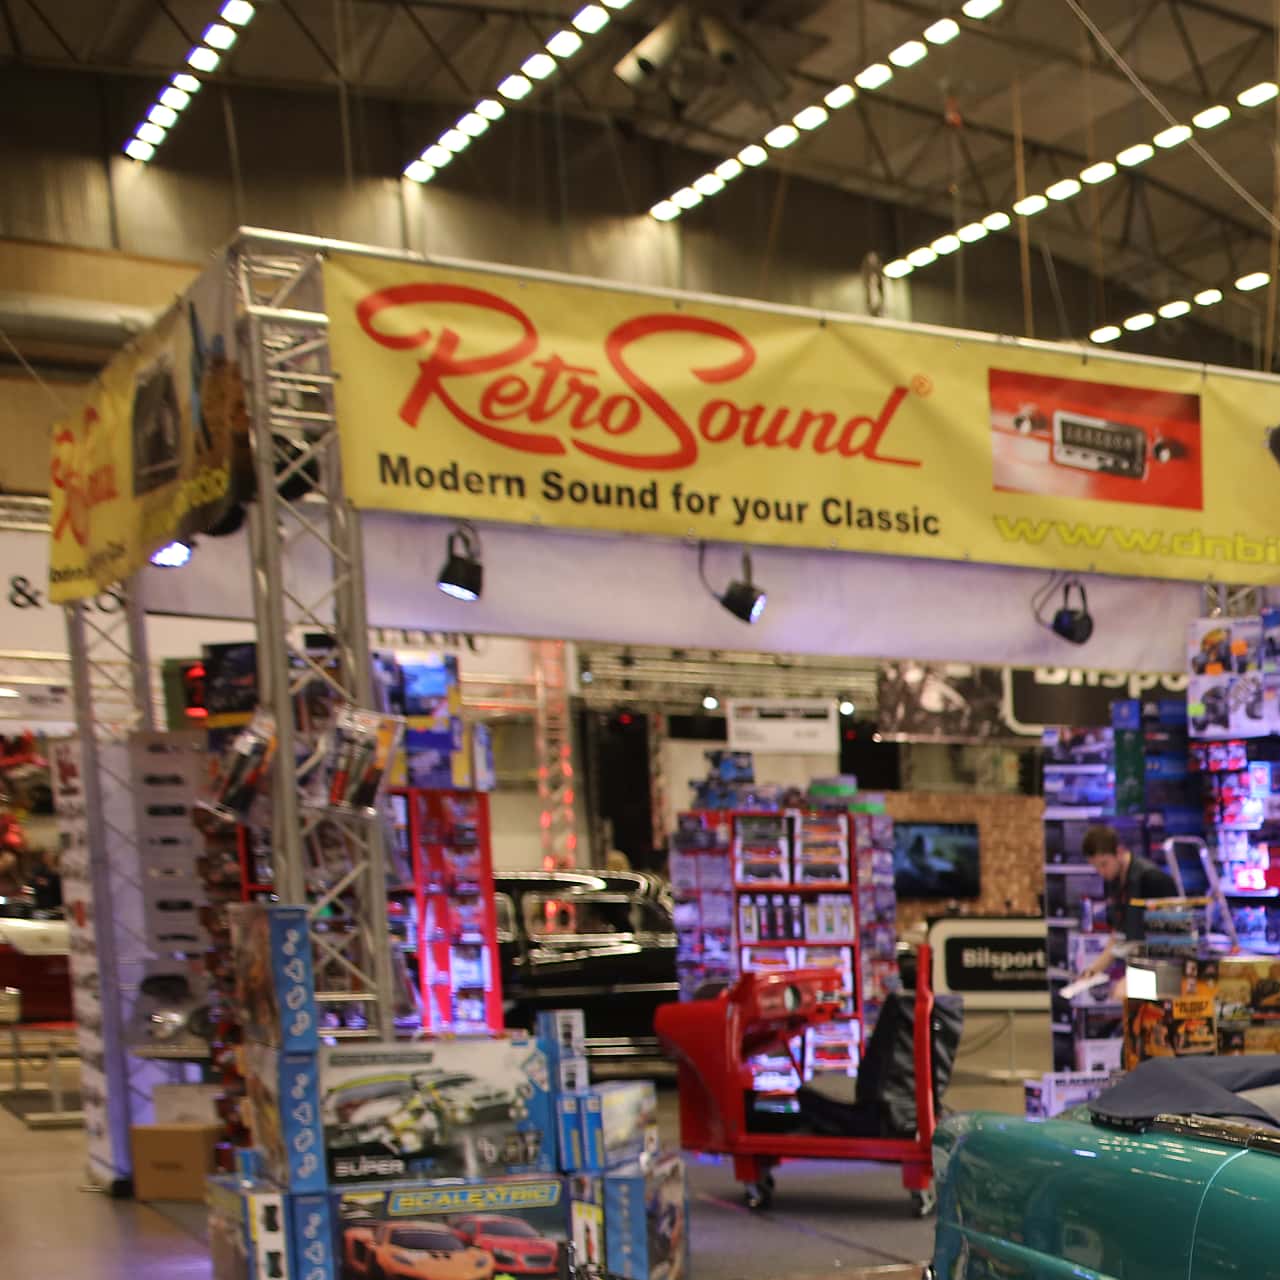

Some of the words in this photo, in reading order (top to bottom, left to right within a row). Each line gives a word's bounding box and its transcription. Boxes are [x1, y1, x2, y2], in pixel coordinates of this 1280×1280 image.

[355, 283, 922, 471] RetroSound
[378, 452, 526, 498] Modern
[542, 470, 658, 509] Sound
[672, 480, 720, 515] for
[733, 497, 808, 526] your
[822, 497, 940, 535] Classic
[962, 948, 1046, 970] Bilsport
